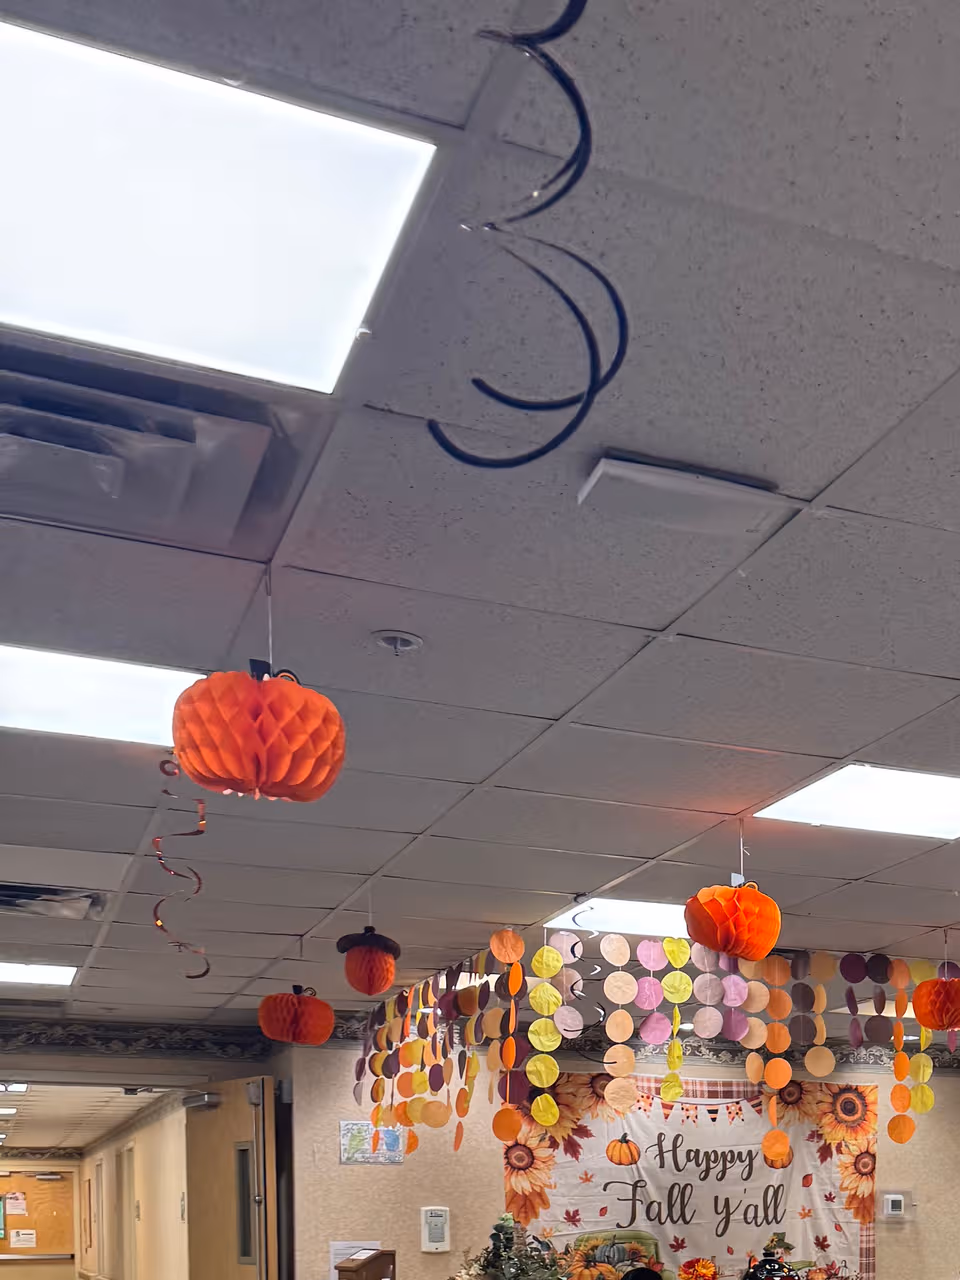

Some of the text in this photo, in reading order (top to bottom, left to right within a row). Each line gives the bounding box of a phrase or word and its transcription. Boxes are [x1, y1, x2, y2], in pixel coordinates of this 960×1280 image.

[645, 1132, 759, 1182] Happy
[602, 1179, 787, 1238] Fall y'all
